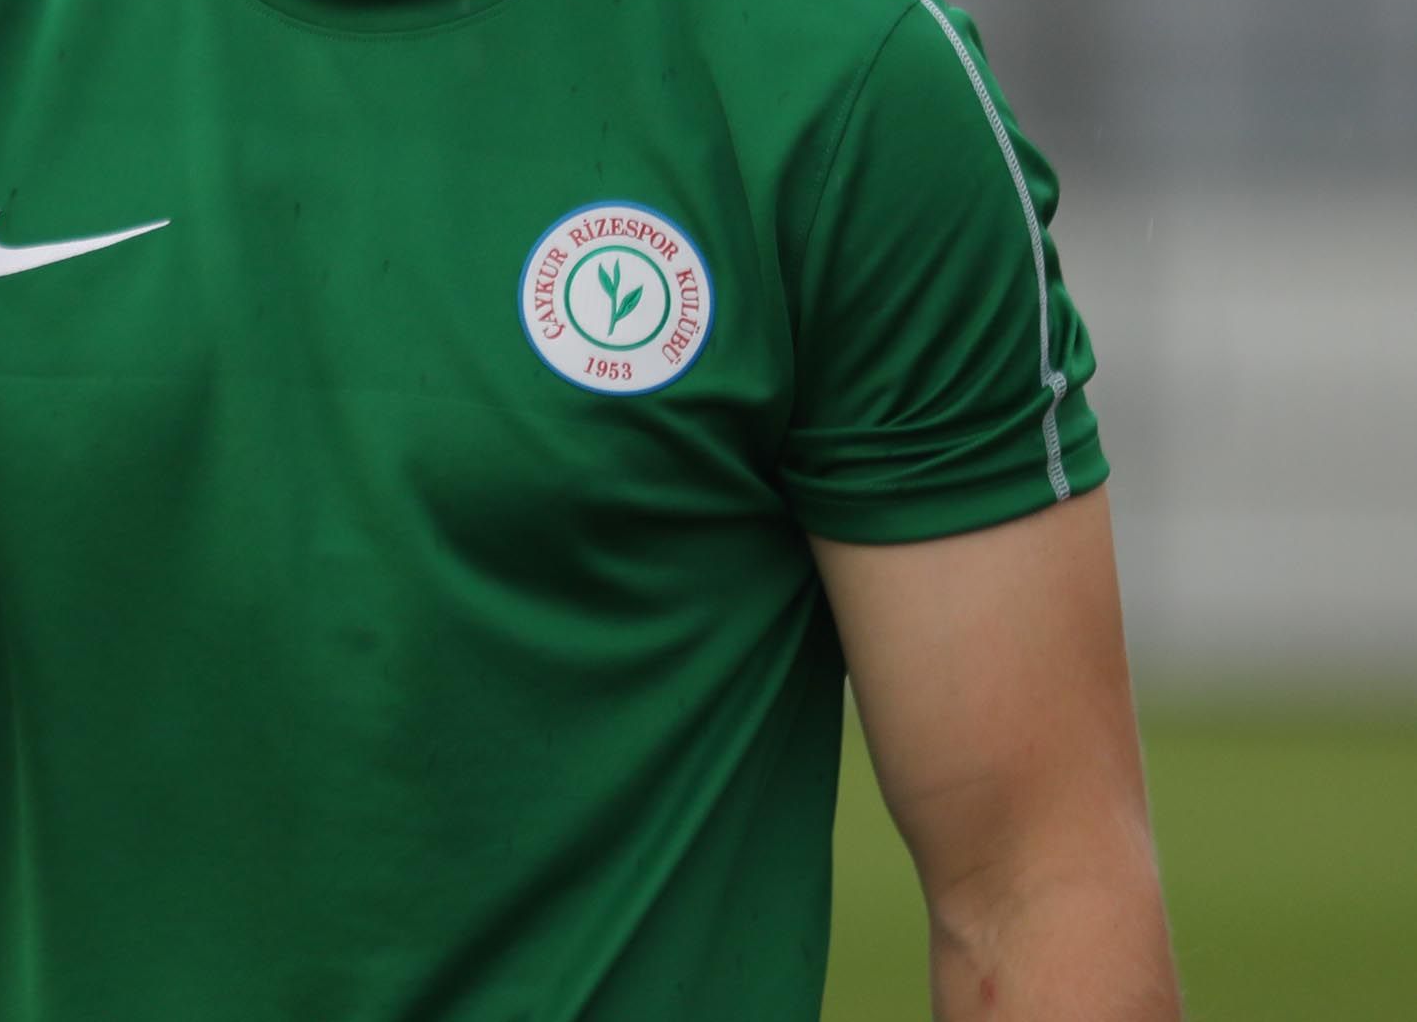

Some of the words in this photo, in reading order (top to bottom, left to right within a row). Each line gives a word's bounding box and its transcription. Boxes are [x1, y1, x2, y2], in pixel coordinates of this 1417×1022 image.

[535, 248, 568, 340] ÇAYKUR
[568, 218, 679, 262] RİZESPOR
[661, 268, 701, 365] KULÜBÜ
[584, 357, 632, 380] 1953
